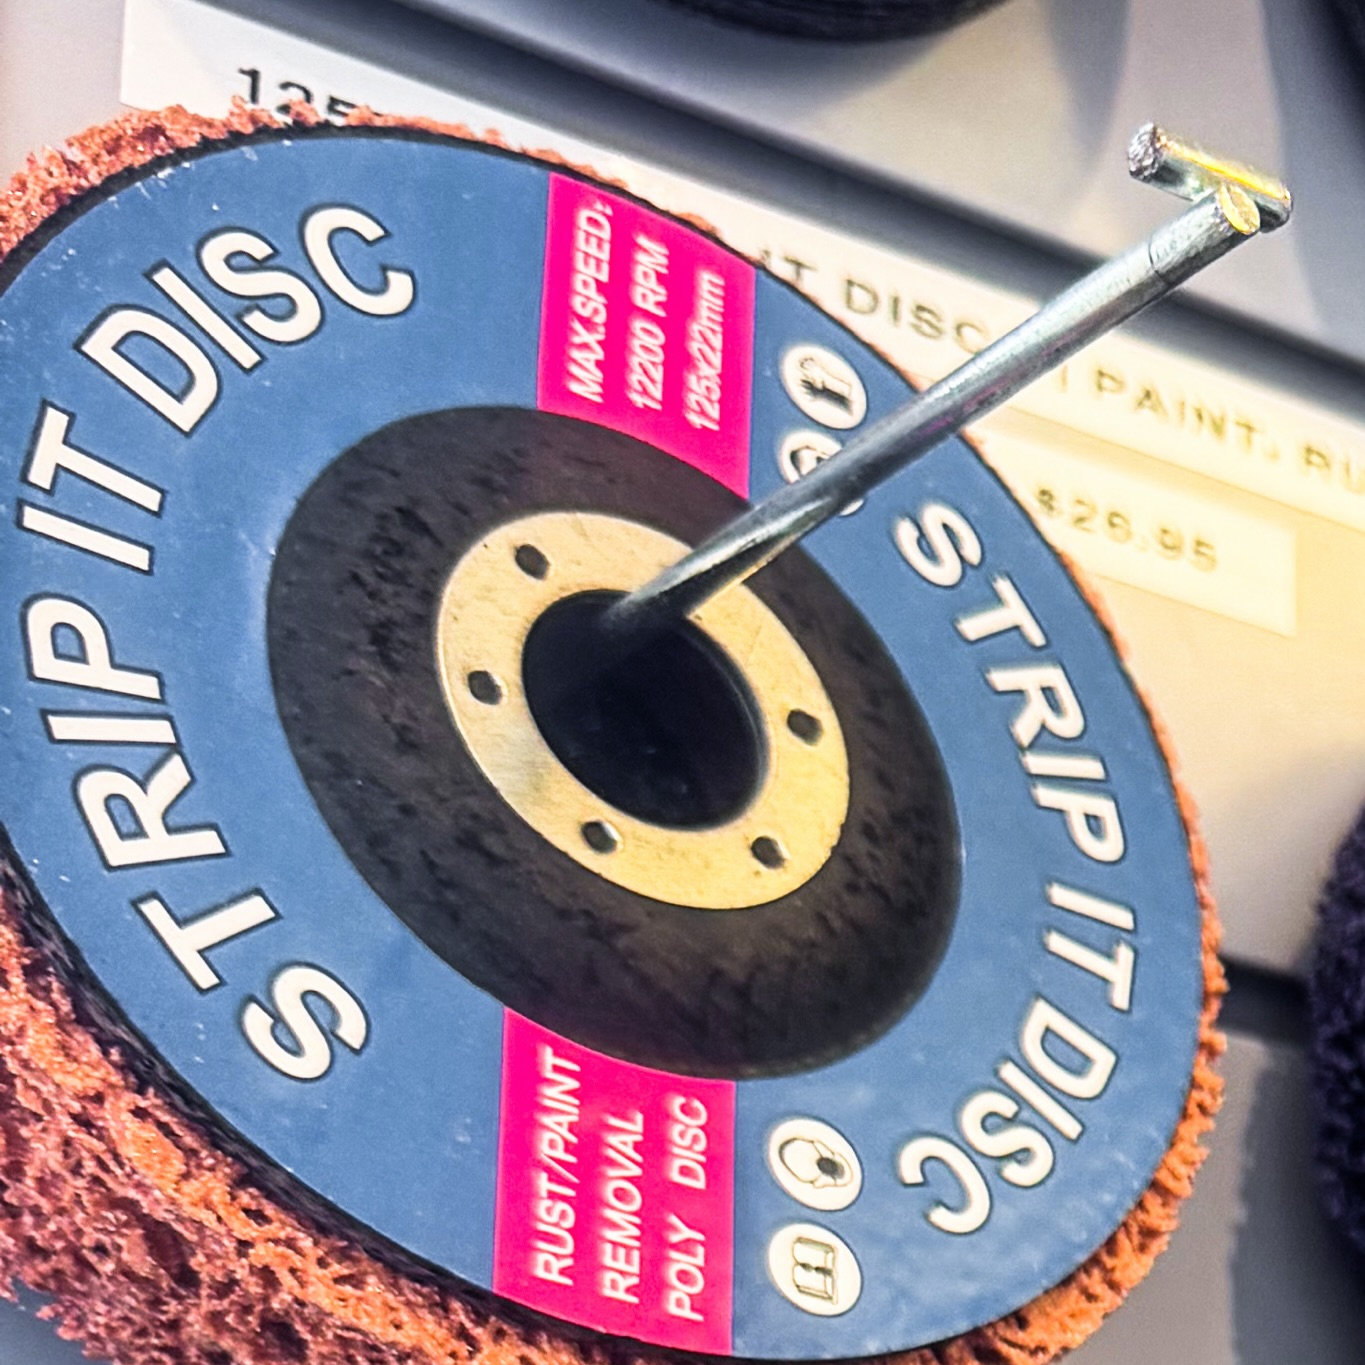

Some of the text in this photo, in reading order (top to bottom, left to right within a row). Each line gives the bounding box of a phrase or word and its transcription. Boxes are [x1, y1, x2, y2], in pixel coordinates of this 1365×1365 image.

[566, 200, 614, 404] MAX.SPEED:
[629, 235, 670, 412] 12200 RPM
[684, 272, 725, 433] 125x22mm
[843, 278, 994, 355] DISC
[17, 203, 416, 1081] STRIP IT DISC
[893, 501, 1136, 1235] STRIP IT DISC
[531, 1046, 585, 1287] RUST/PAINT
[599, 1109, 646, 1306] REMOVAL
[665, 1095, 711, 1323] POLY DISC
